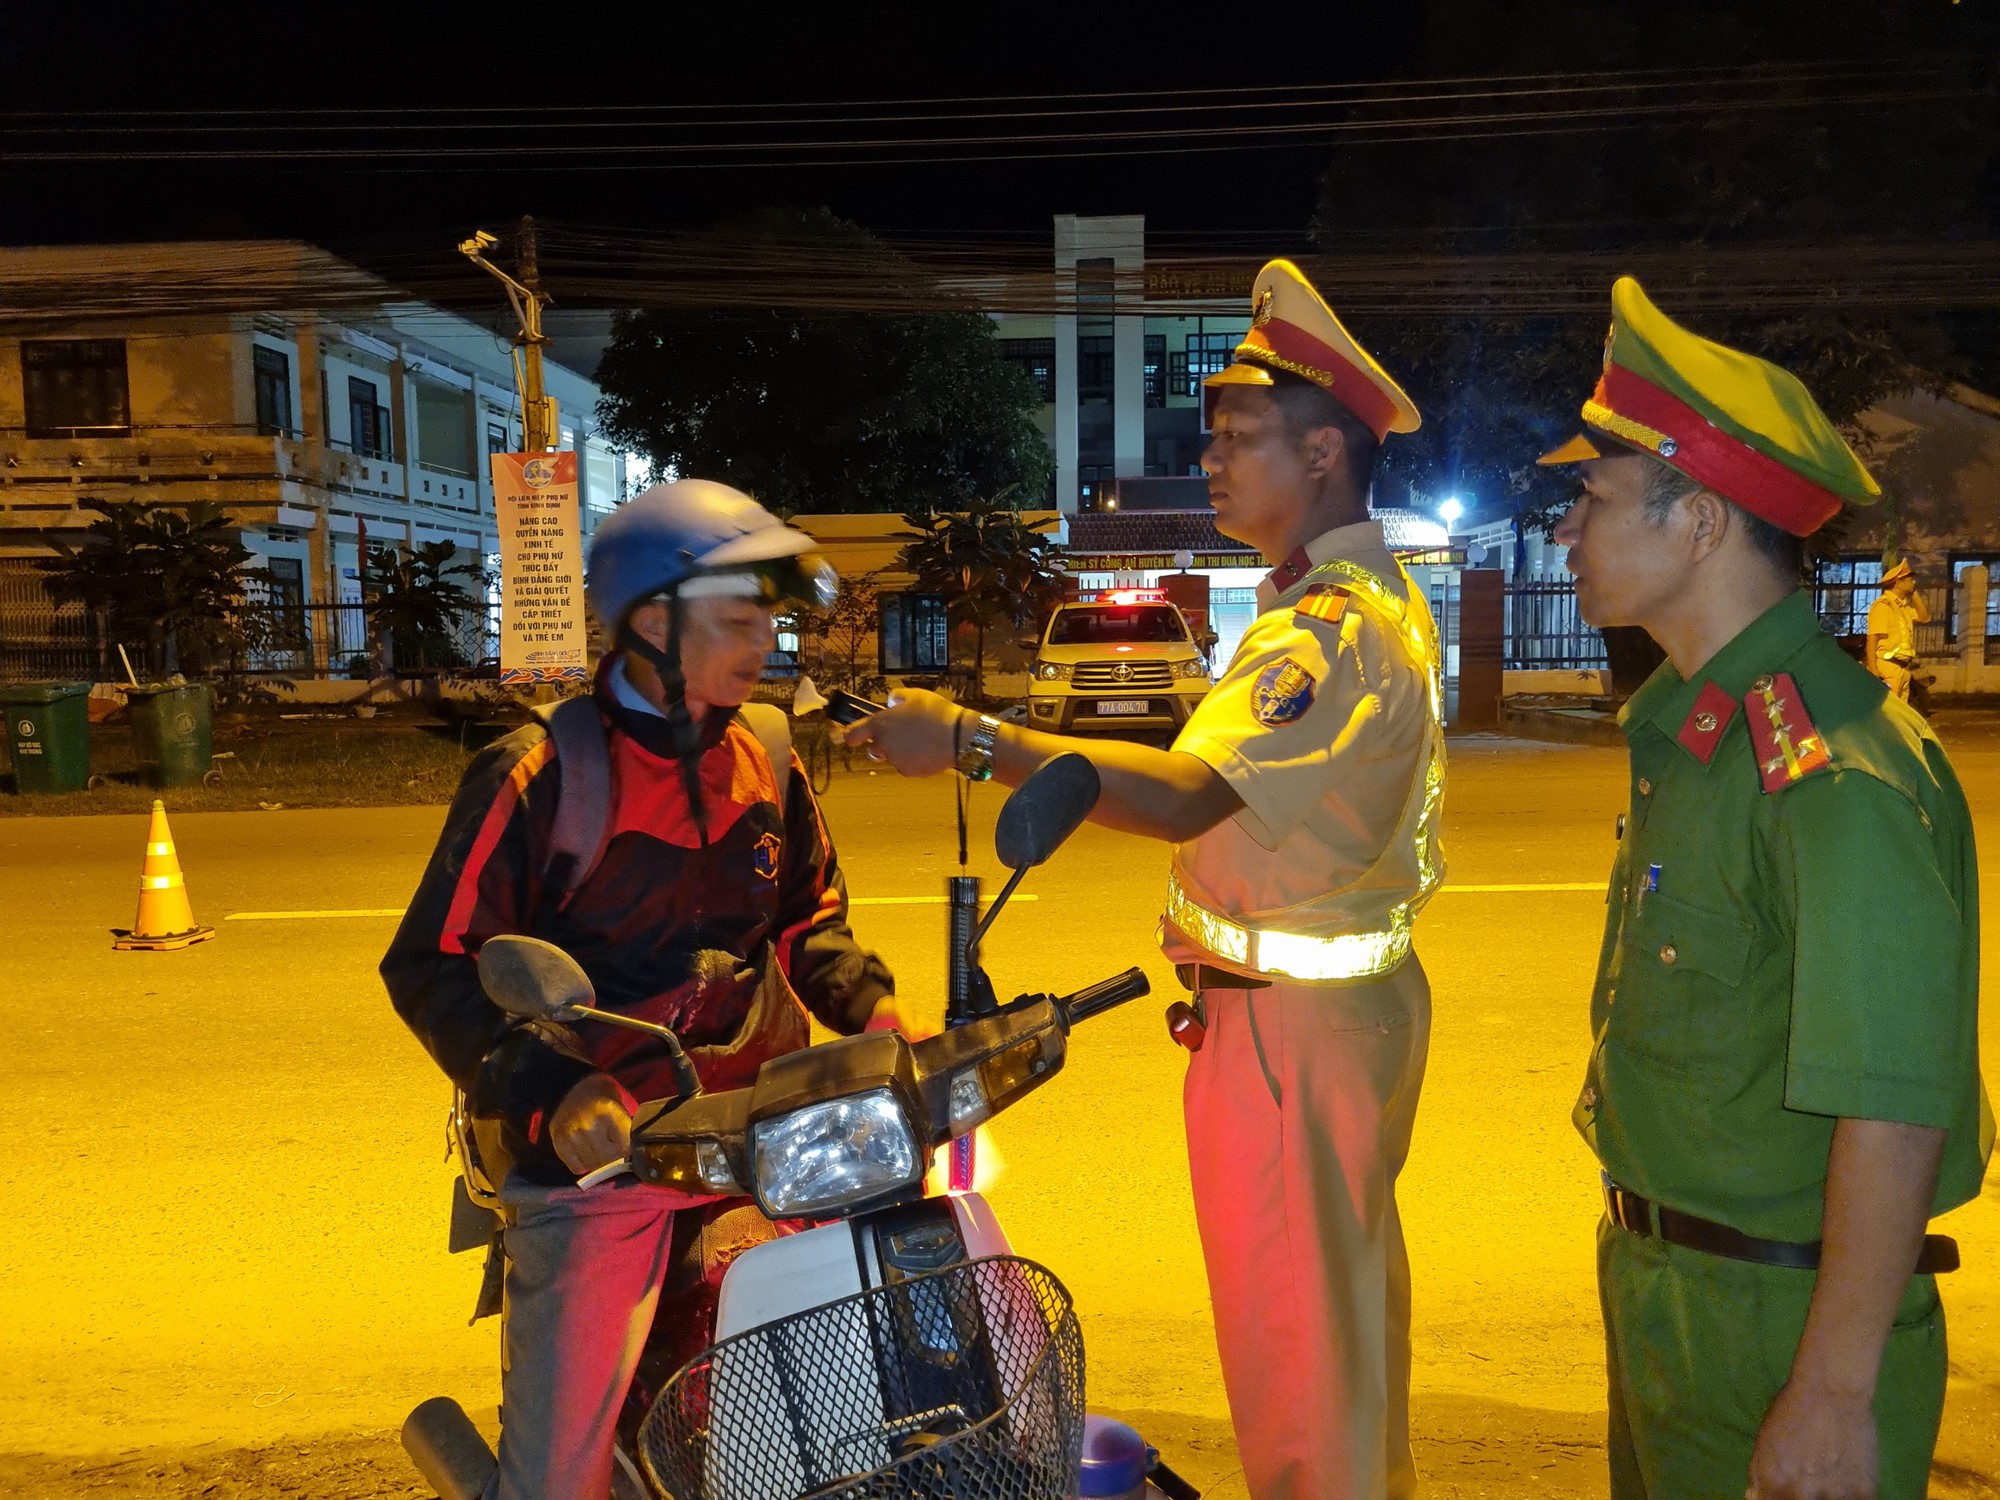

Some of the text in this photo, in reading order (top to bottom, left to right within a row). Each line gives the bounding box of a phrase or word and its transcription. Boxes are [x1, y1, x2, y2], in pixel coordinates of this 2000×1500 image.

[519, 516, 558, 526] NÂNG CAO
[541, 527, 564, 537] NĂNG
[524, 538, 554, 549] KINH TẾ
[517, 551, 564, 563] CHO PHỤ NỮ
[1100, 557, 1122, 568] CÔNG
[1124, 557, 1136, 568] AN
[1138, 556, 1164, 570] HUYỆN
[1206, 556, 1219, 567] THI
[1221, 555, 1237, 566] ĐUA
[1239, 555, 1254, 567] HỌC
[522, 562, 559, 572] THÚC ĐẨY
[513, 573, 572, 584] BÌNH ĐẲNG GIỚI
[515, 585, 569, 596] VÀ GIẢI QUYẾT
[514, 596, 571, 608] NHỮNG VẤN ĐỀ
[522, 609, 562, 619] CẤP THIẾT
[513, 620, 573, 632] ĐỐI VỚI PHỤ NỮ
[522, 631, 564, 642] VÀ TRẺ EM
